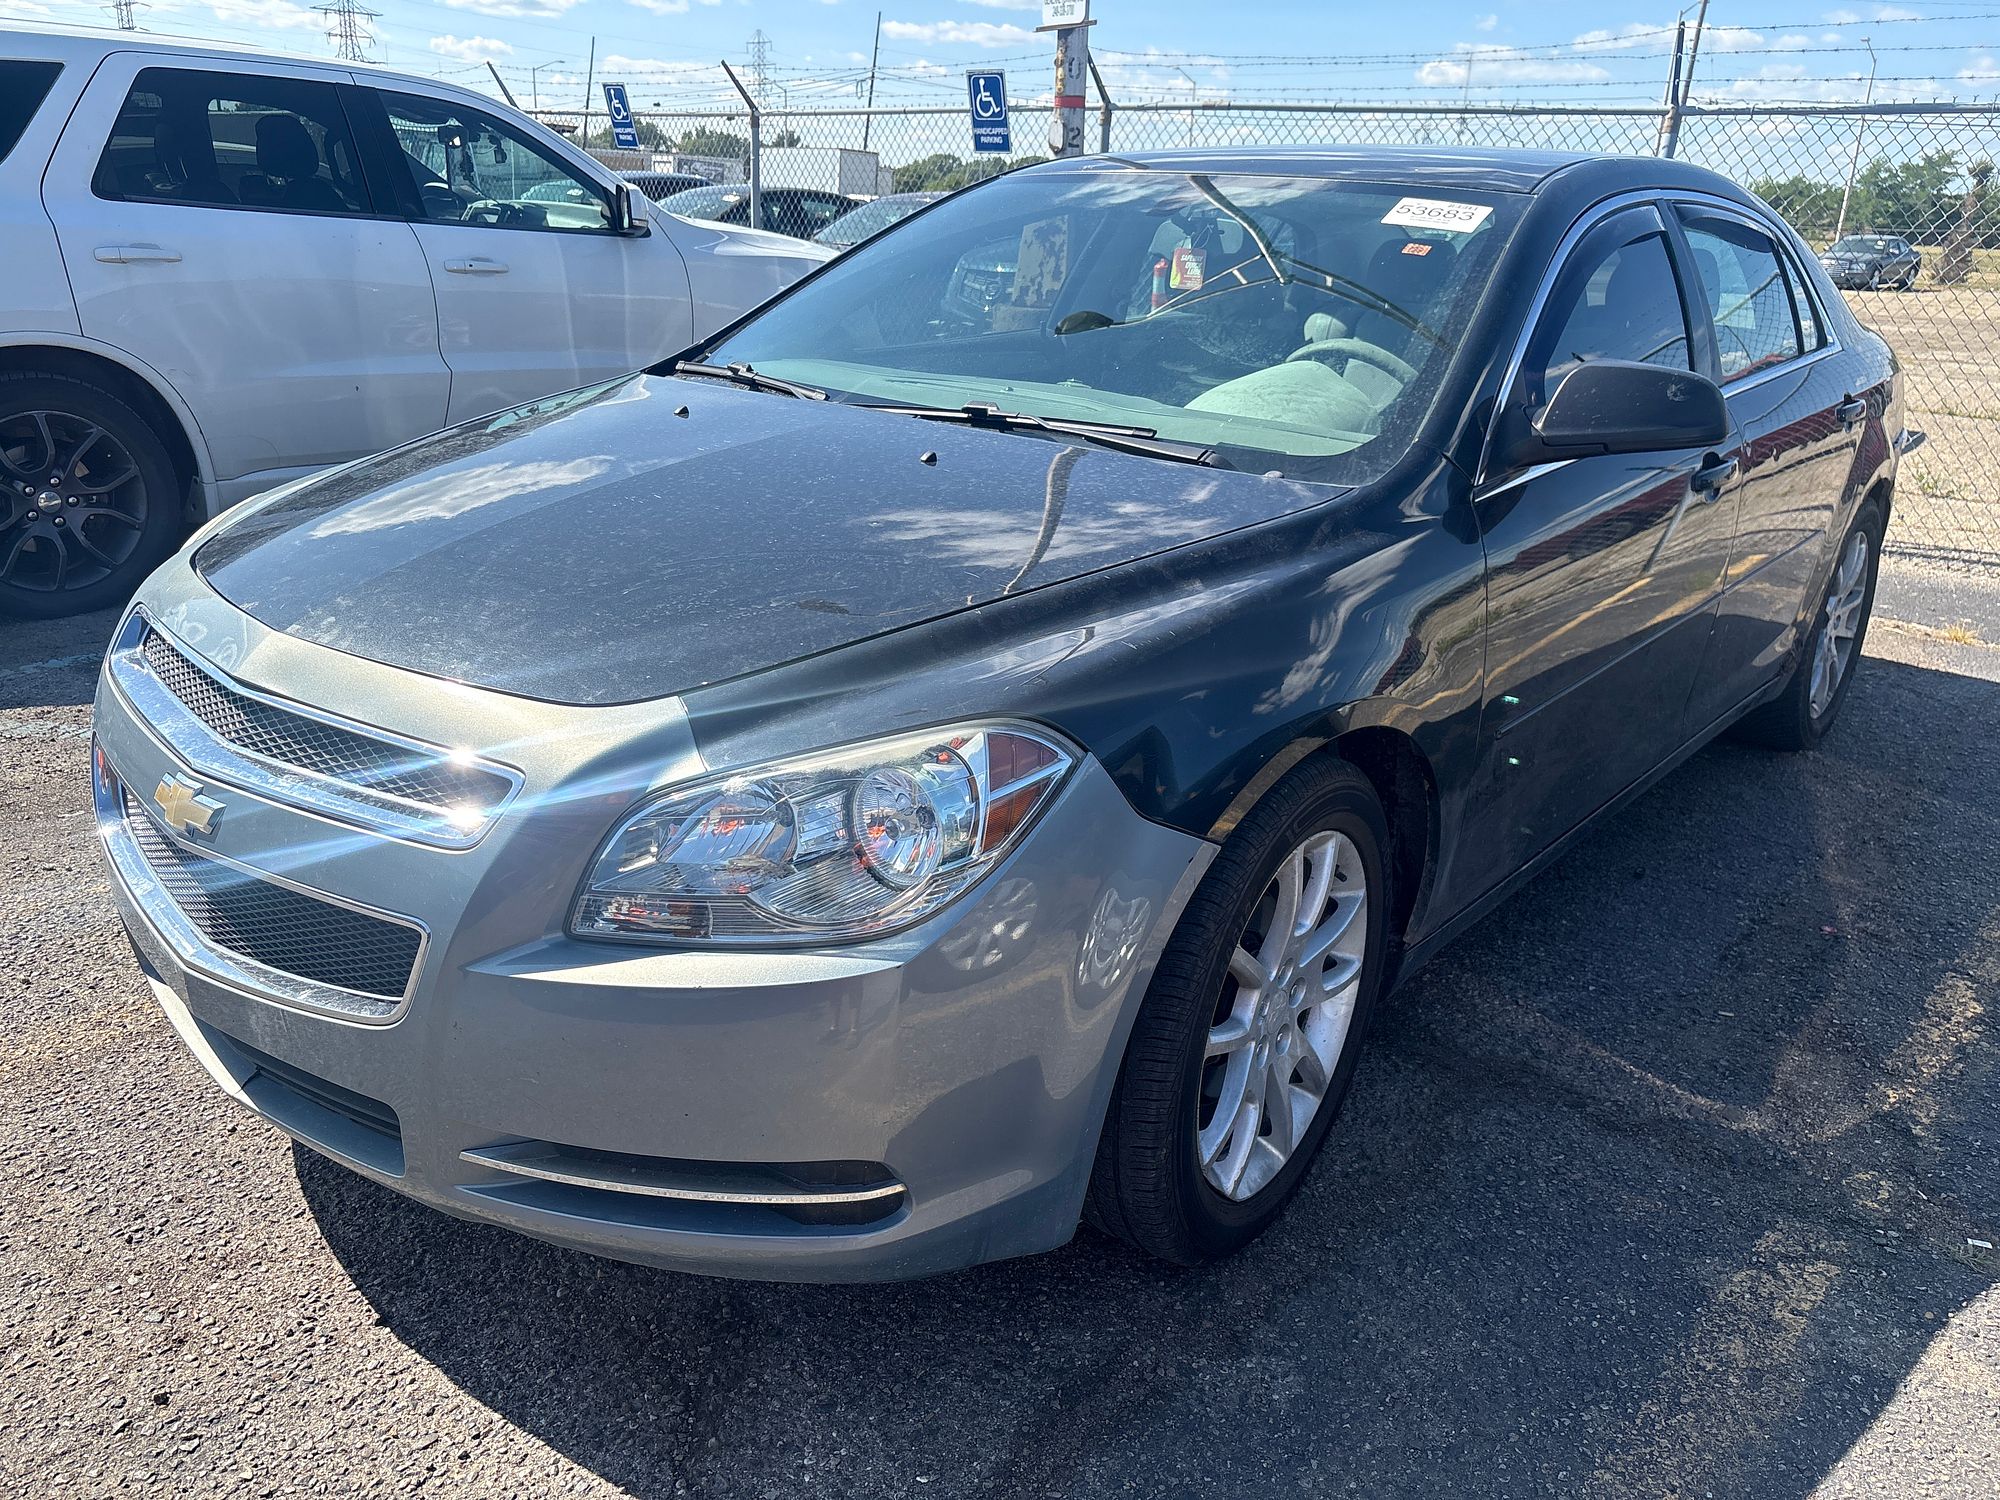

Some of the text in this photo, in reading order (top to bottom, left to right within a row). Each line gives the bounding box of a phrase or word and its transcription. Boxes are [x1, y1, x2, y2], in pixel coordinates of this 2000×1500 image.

[973, 127, 1009, 135] HANDICAPPED
[980, 136, 1004, 144] PARKING
[1396, 204, 1475, 221] 53683
